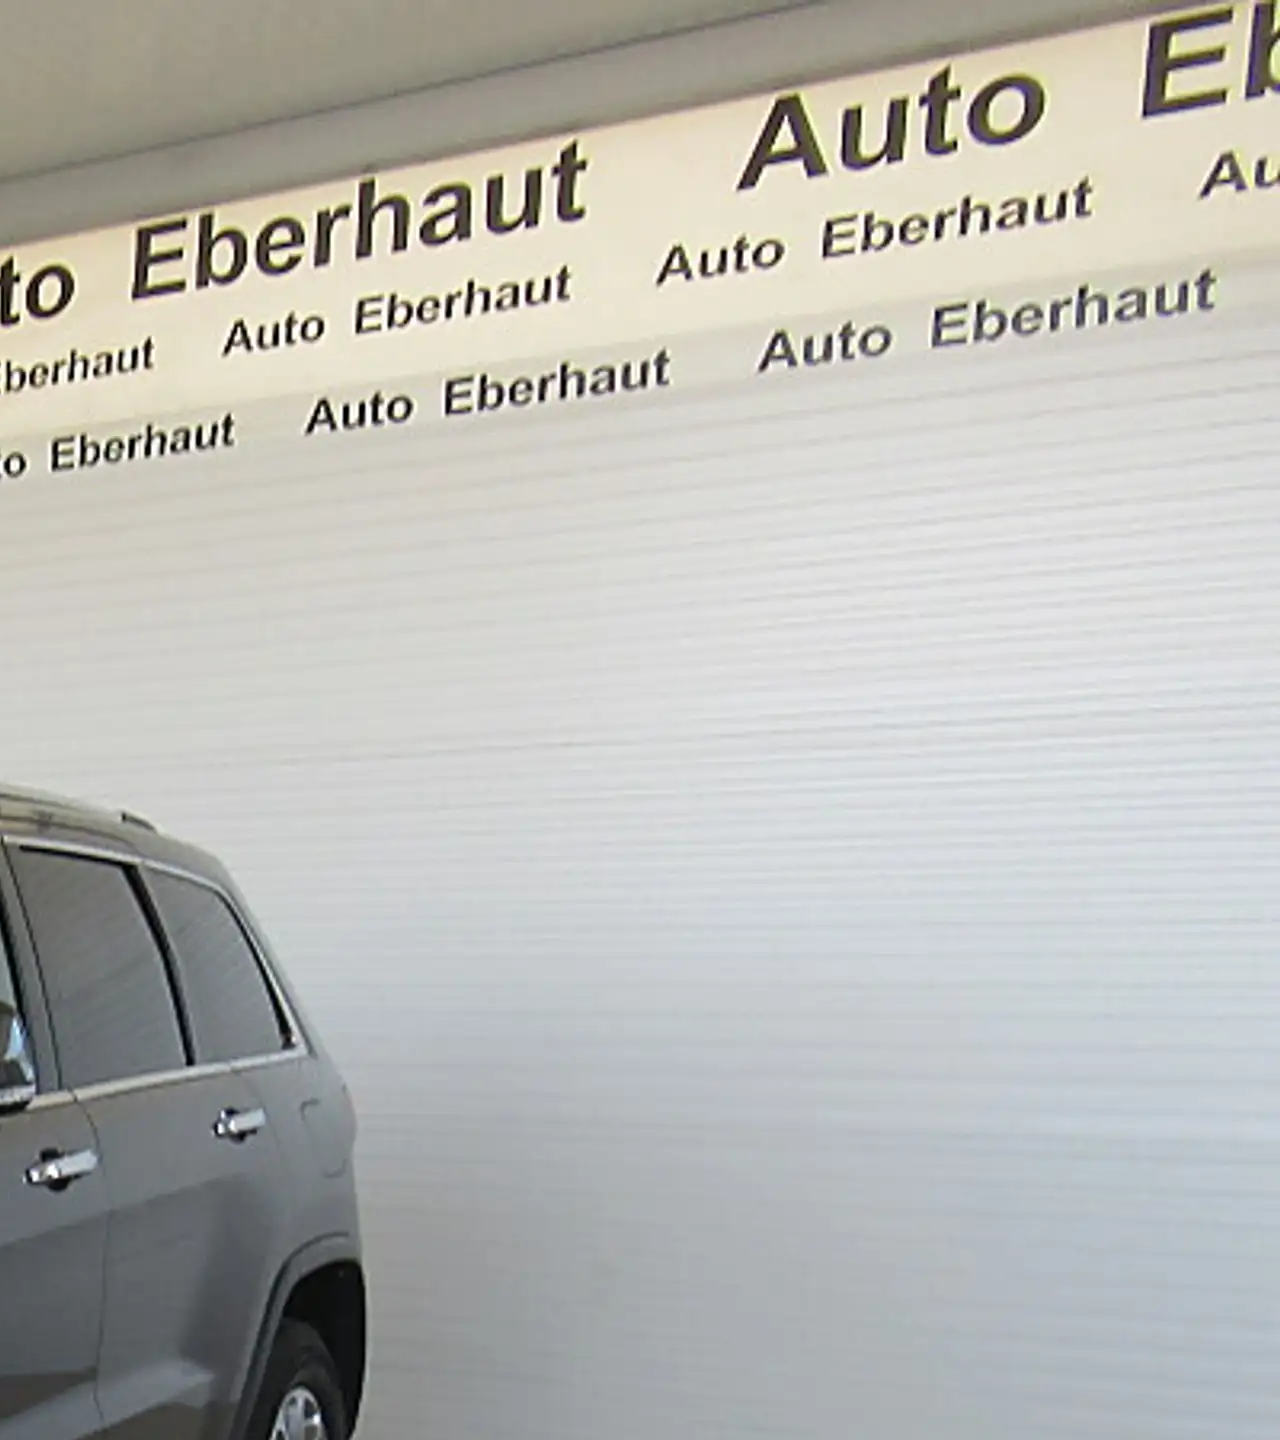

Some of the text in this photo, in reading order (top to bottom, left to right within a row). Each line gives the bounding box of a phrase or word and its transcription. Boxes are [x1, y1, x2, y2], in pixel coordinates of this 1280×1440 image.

[735, 63, 1047, 192] Auto
[130, 139, 587, 300] Eberhaut
[656, 177, 1093, 287] Auto Eberhaut
[221, 265, 571, 357] Auto Eberhaut
[757, 268, 1217, 373] Auto Eberhaut
[50, 413, 235, 474] Eberhaut
[305, 350, 670, 435] Auto Eberhaut
